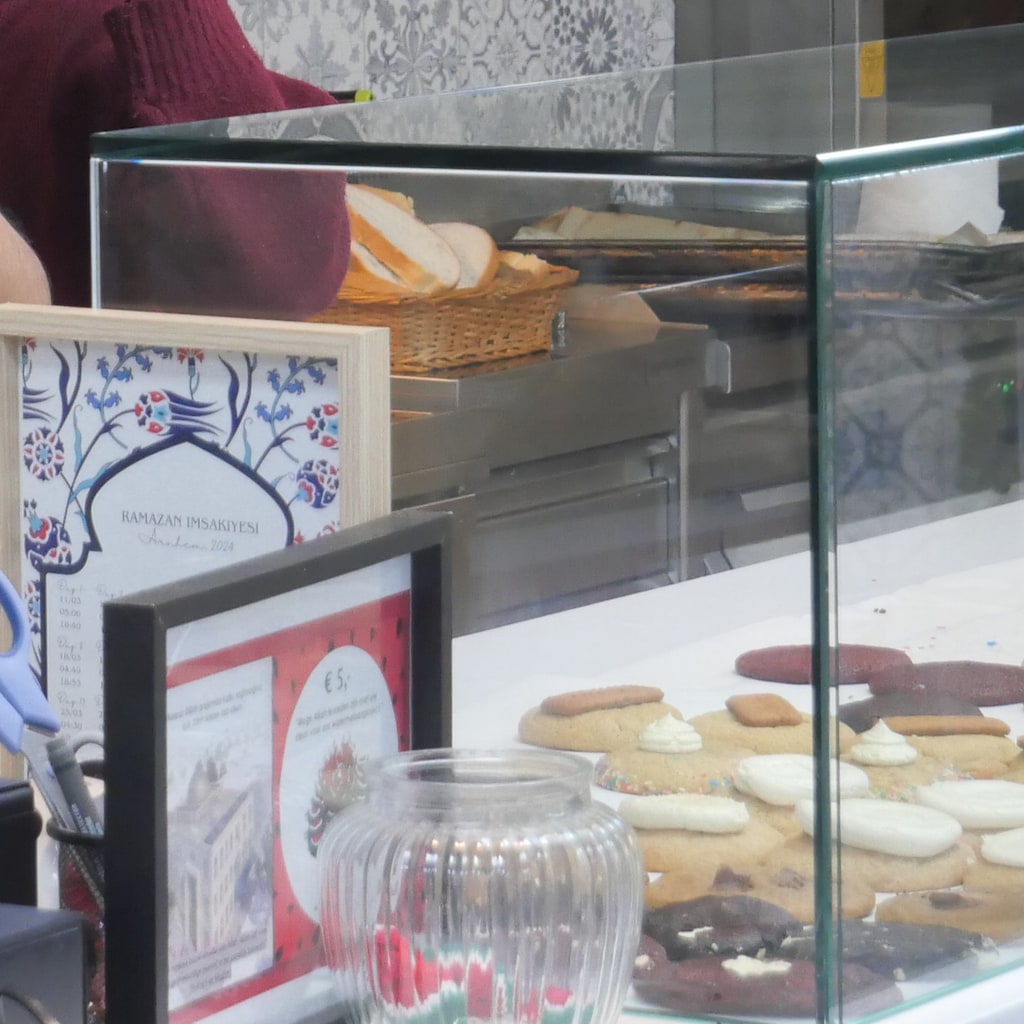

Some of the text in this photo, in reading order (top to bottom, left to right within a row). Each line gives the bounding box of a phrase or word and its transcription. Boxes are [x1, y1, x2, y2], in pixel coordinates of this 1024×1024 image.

[122, 510, 259, 534] RAMAZAN IMSAKIYESI
[210, 539, 234, 552] 2024
[324, 670, 334, 694] €
